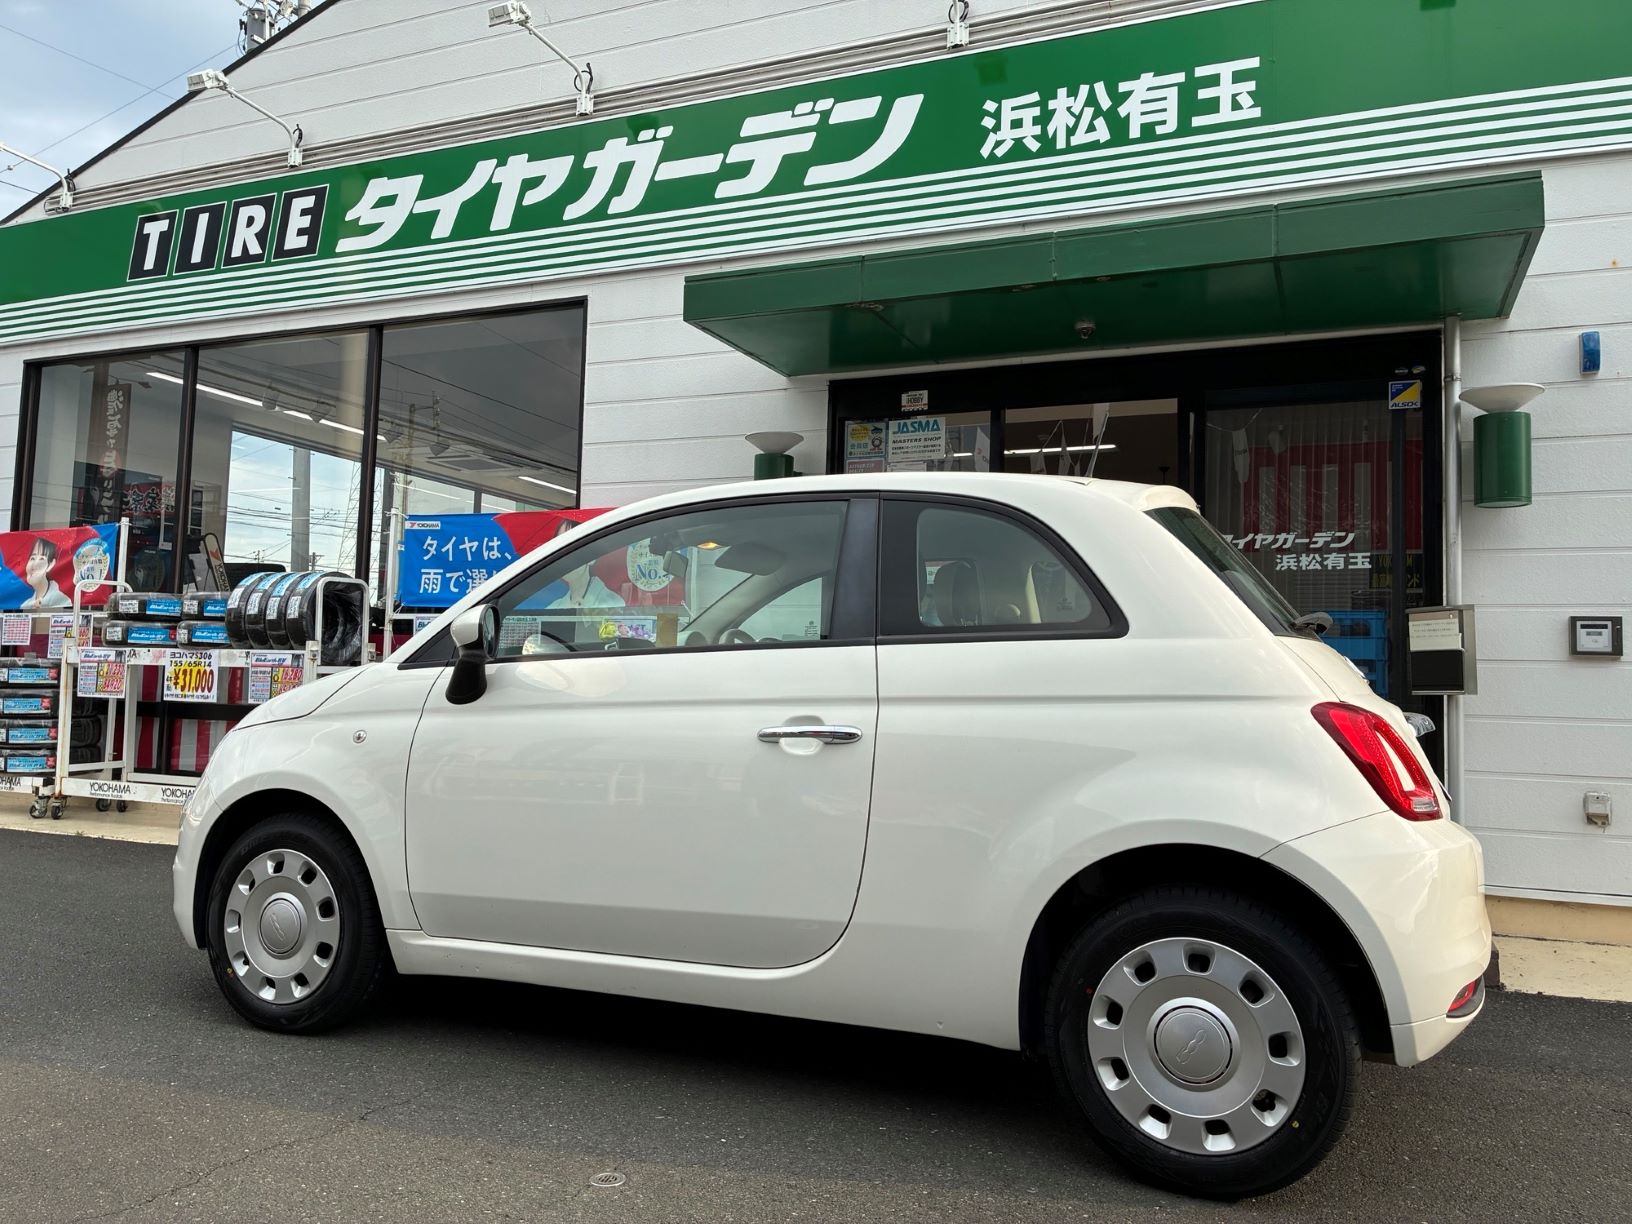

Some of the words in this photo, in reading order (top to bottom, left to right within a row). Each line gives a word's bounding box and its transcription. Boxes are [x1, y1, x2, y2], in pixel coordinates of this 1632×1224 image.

[142, 194, 317, 271] TIRE
[335, 93, 925, 253] タイヤガーデン
[979, 56, 1262, 160] 浜松有玉
[892, 418, 941, 434] JASMA
[422, 535, 512, 562] タイヤは、
[1275, 552, 1372, 571] 浜松有玉
[169, 651, 213, 660] ヨコハマS306
[169, 660, 212, 668] 155/65R14
[90, 782, 131, 794] YOKOHAMA
[161, 788, 195, 799] YOKOHA
